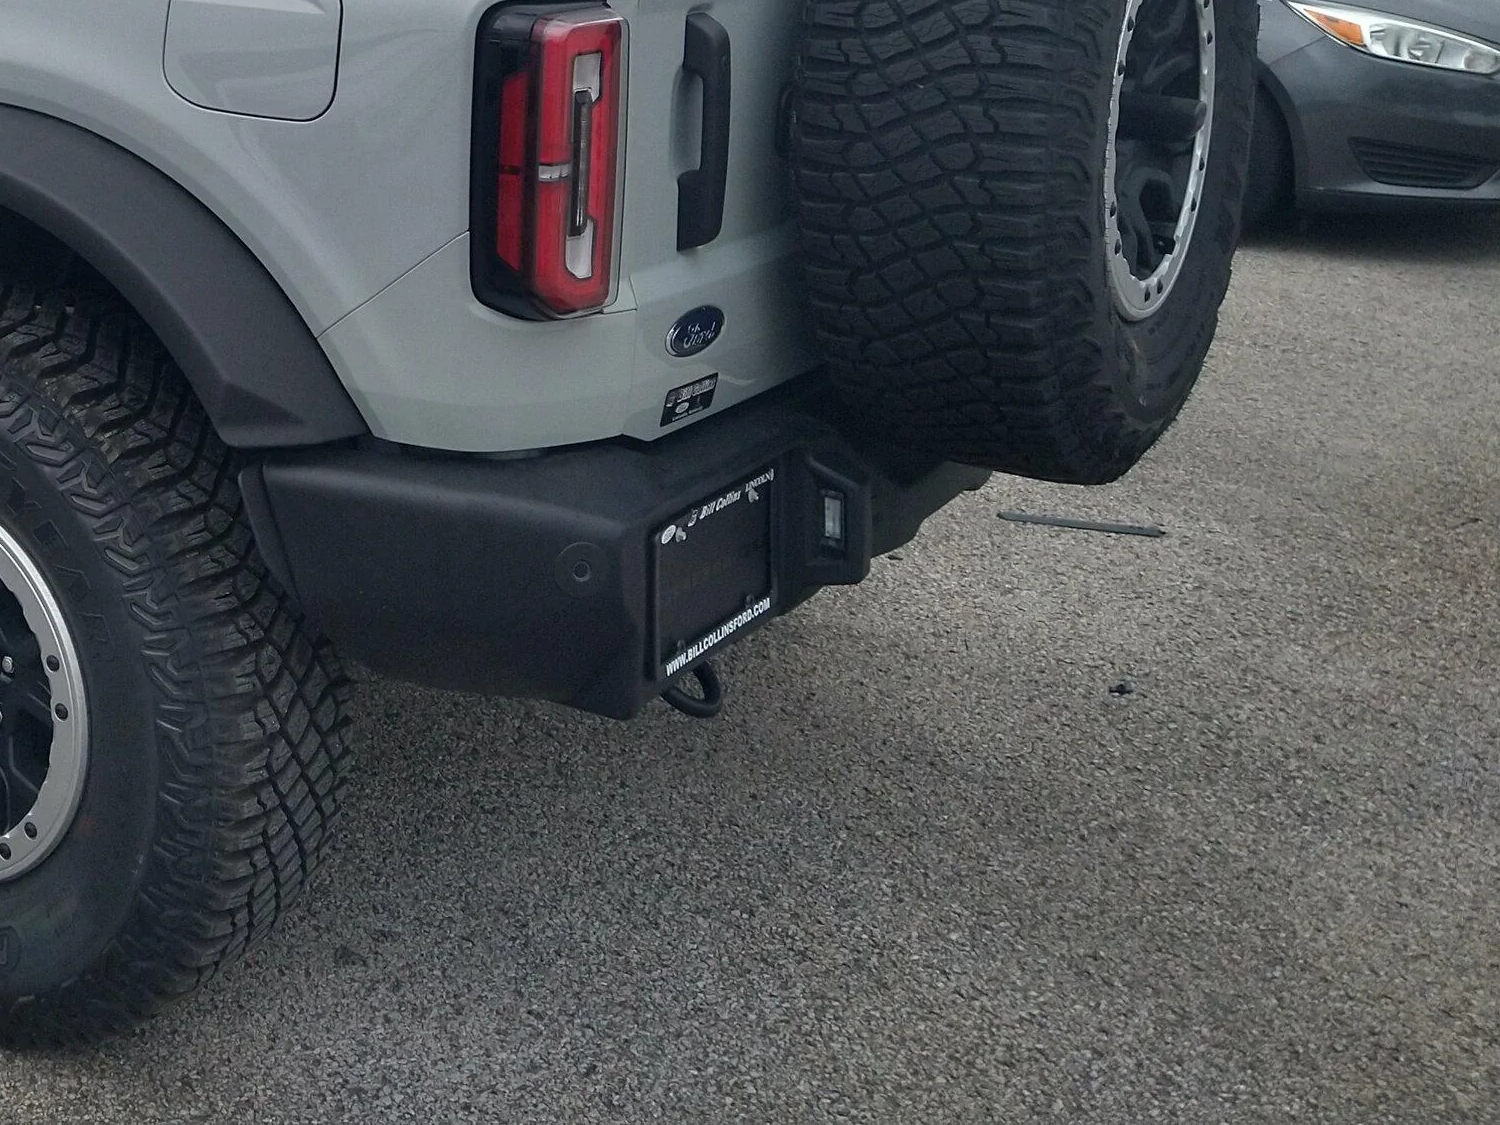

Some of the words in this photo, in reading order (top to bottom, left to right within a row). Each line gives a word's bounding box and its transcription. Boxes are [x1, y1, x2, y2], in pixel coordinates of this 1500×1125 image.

[699, 501, 716, 520] Bill
[716, 490, 742, 511] Collins
[745, 472, 772, 492] LINCOLN
[665, 597, 771, 677] WWW.BILLCOLLINSFORD.COM
